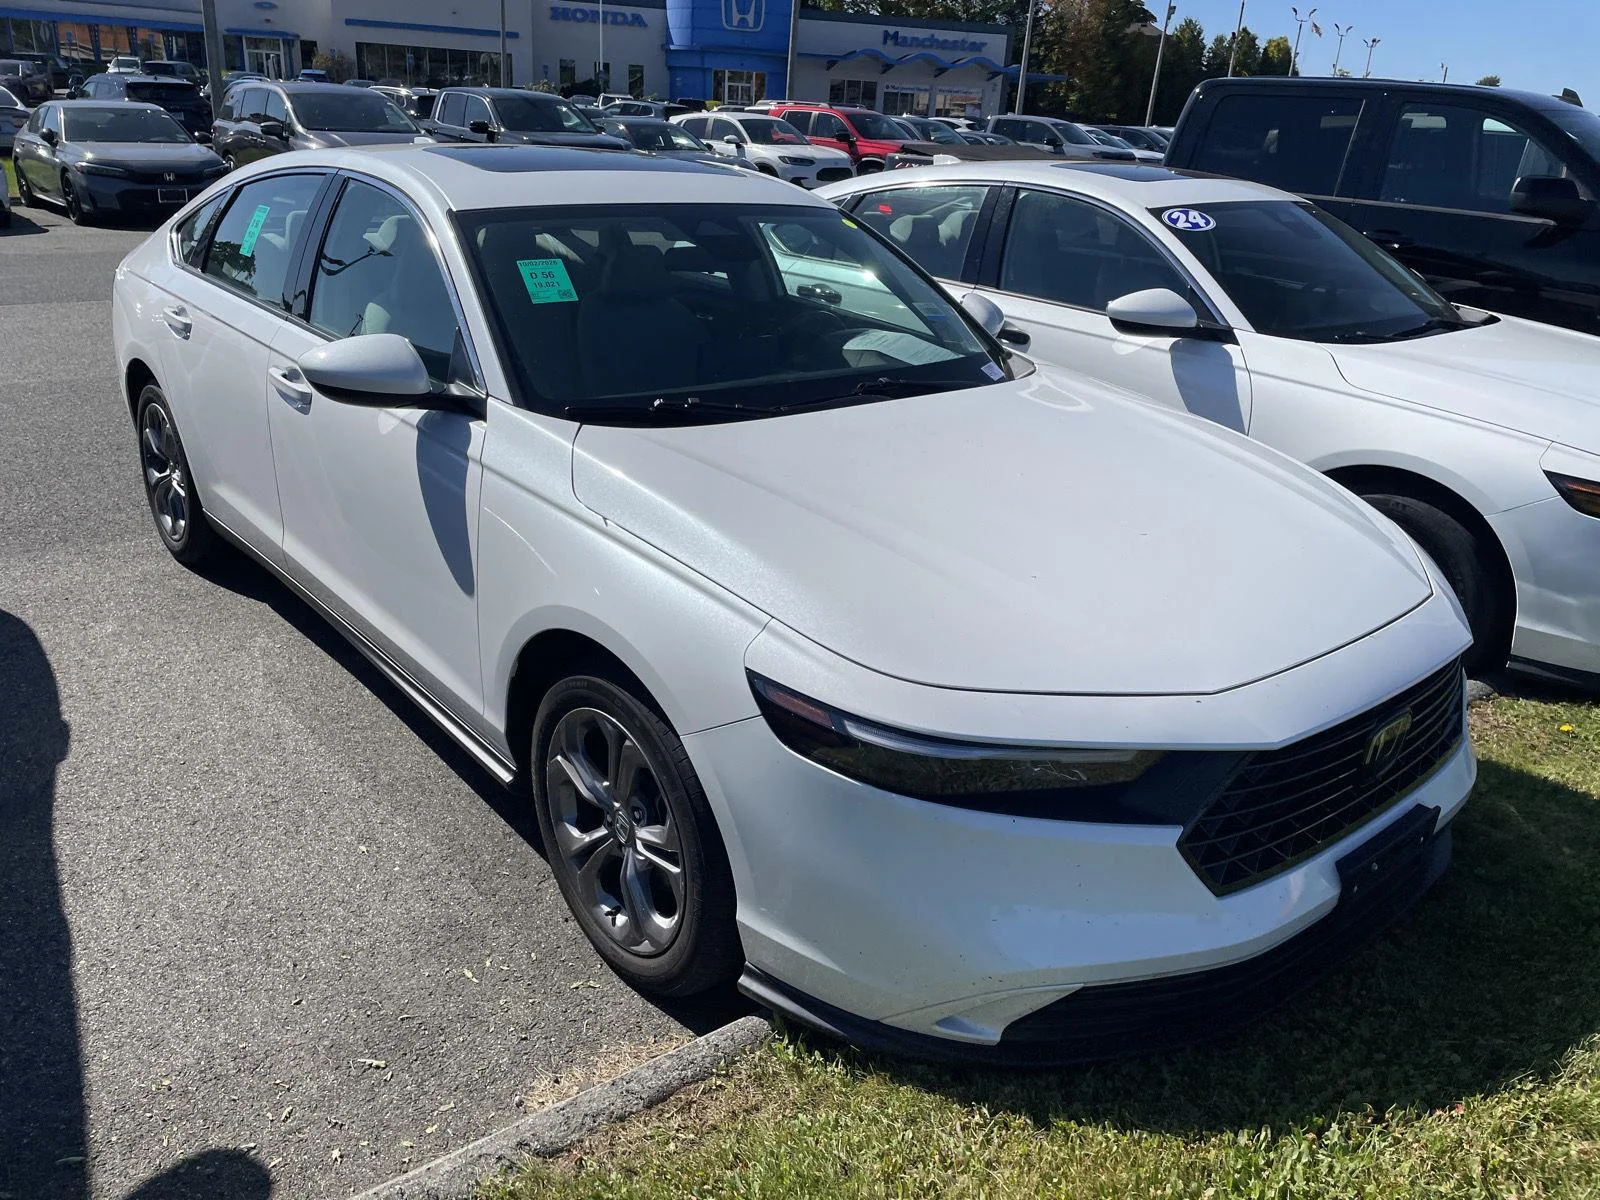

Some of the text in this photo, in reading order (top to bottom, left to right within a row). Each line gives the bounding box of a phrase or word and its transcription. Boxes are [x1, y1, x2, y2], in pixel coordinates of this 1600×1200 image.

[550, 6, 649, 28] HONDA
[882, 29, 988, 52] Manchester
[1170, 210, 1207, 228] 24
